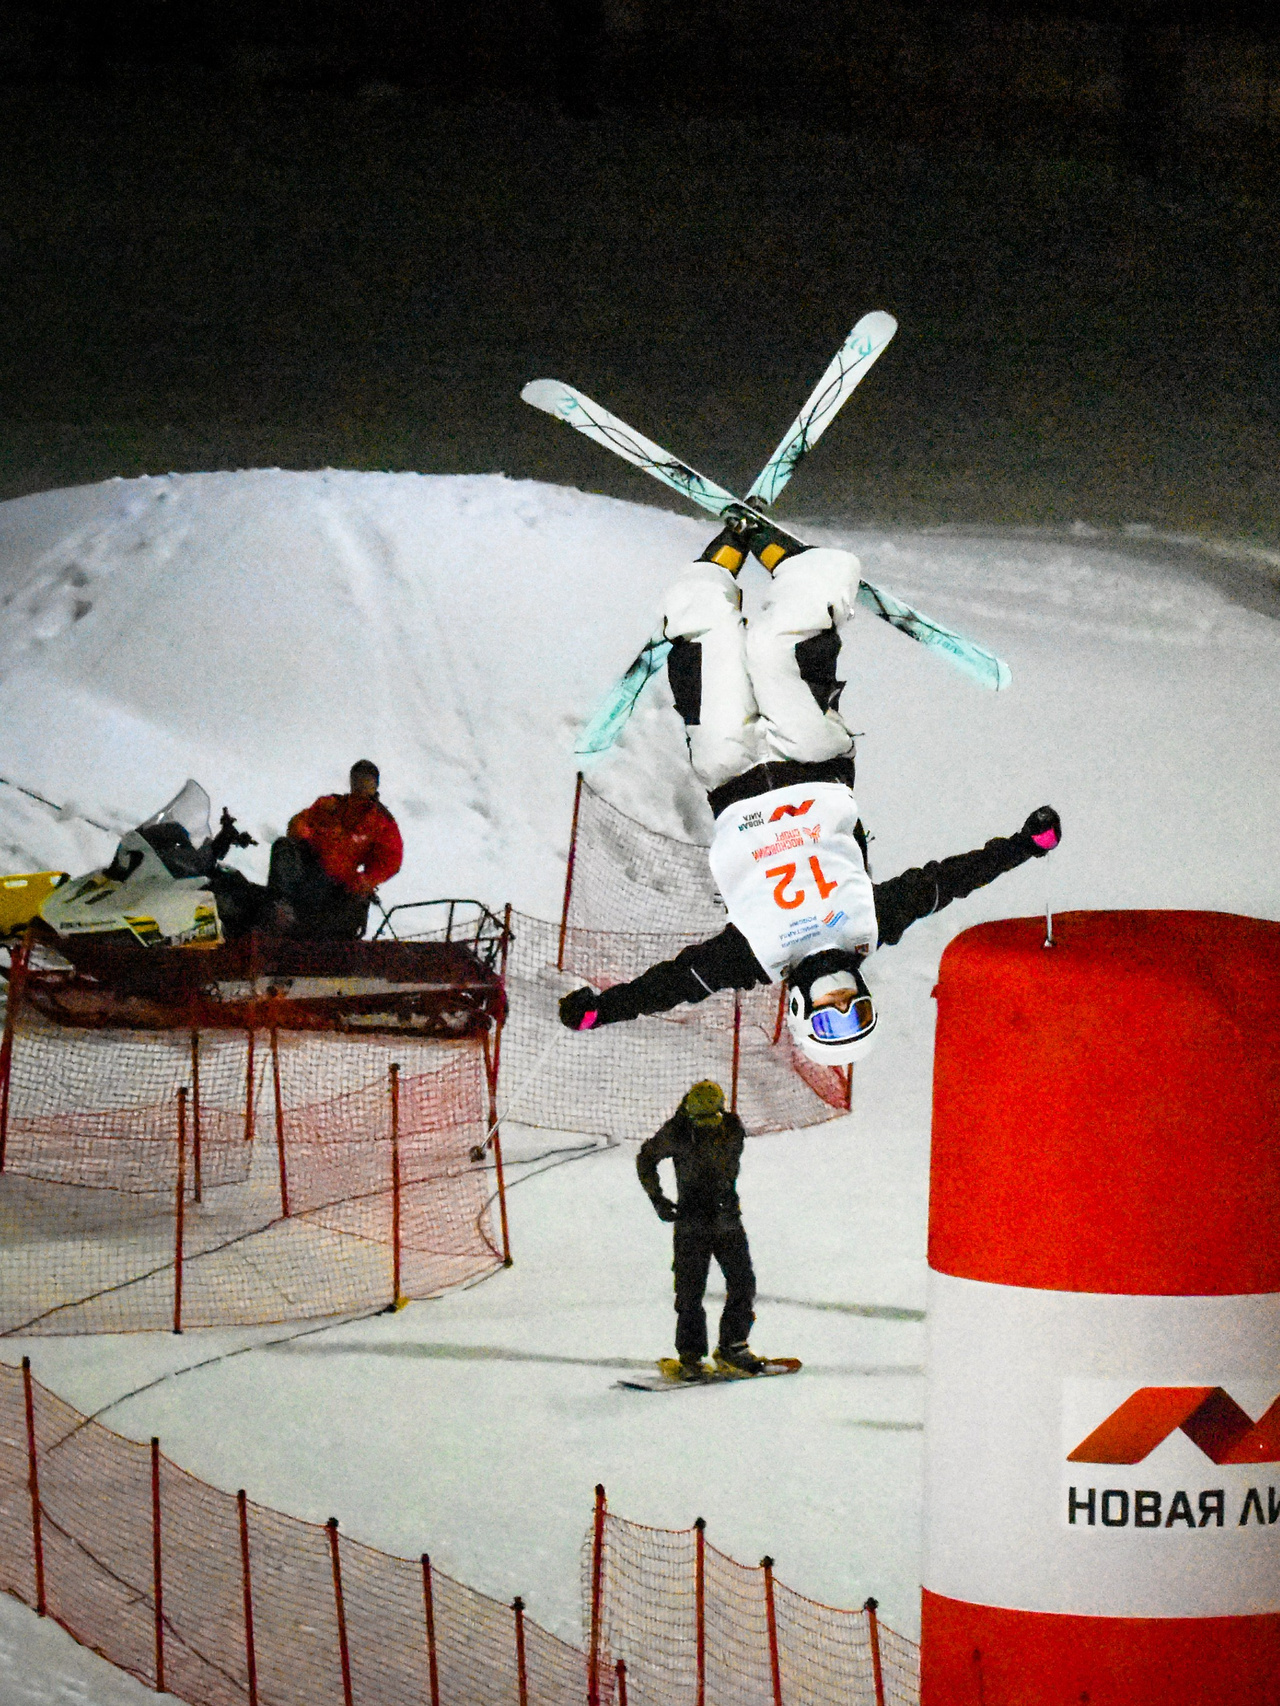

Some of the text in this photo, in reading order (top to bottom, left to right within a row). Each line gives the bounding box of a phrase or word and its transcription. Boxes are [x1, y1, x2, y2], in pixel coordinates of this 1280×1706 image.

[738, 818, 765, 832] НОВАЯ
[765, 855, 838, 910] 12
[1068, 1486, 1225, 1528] НОВАЯ
